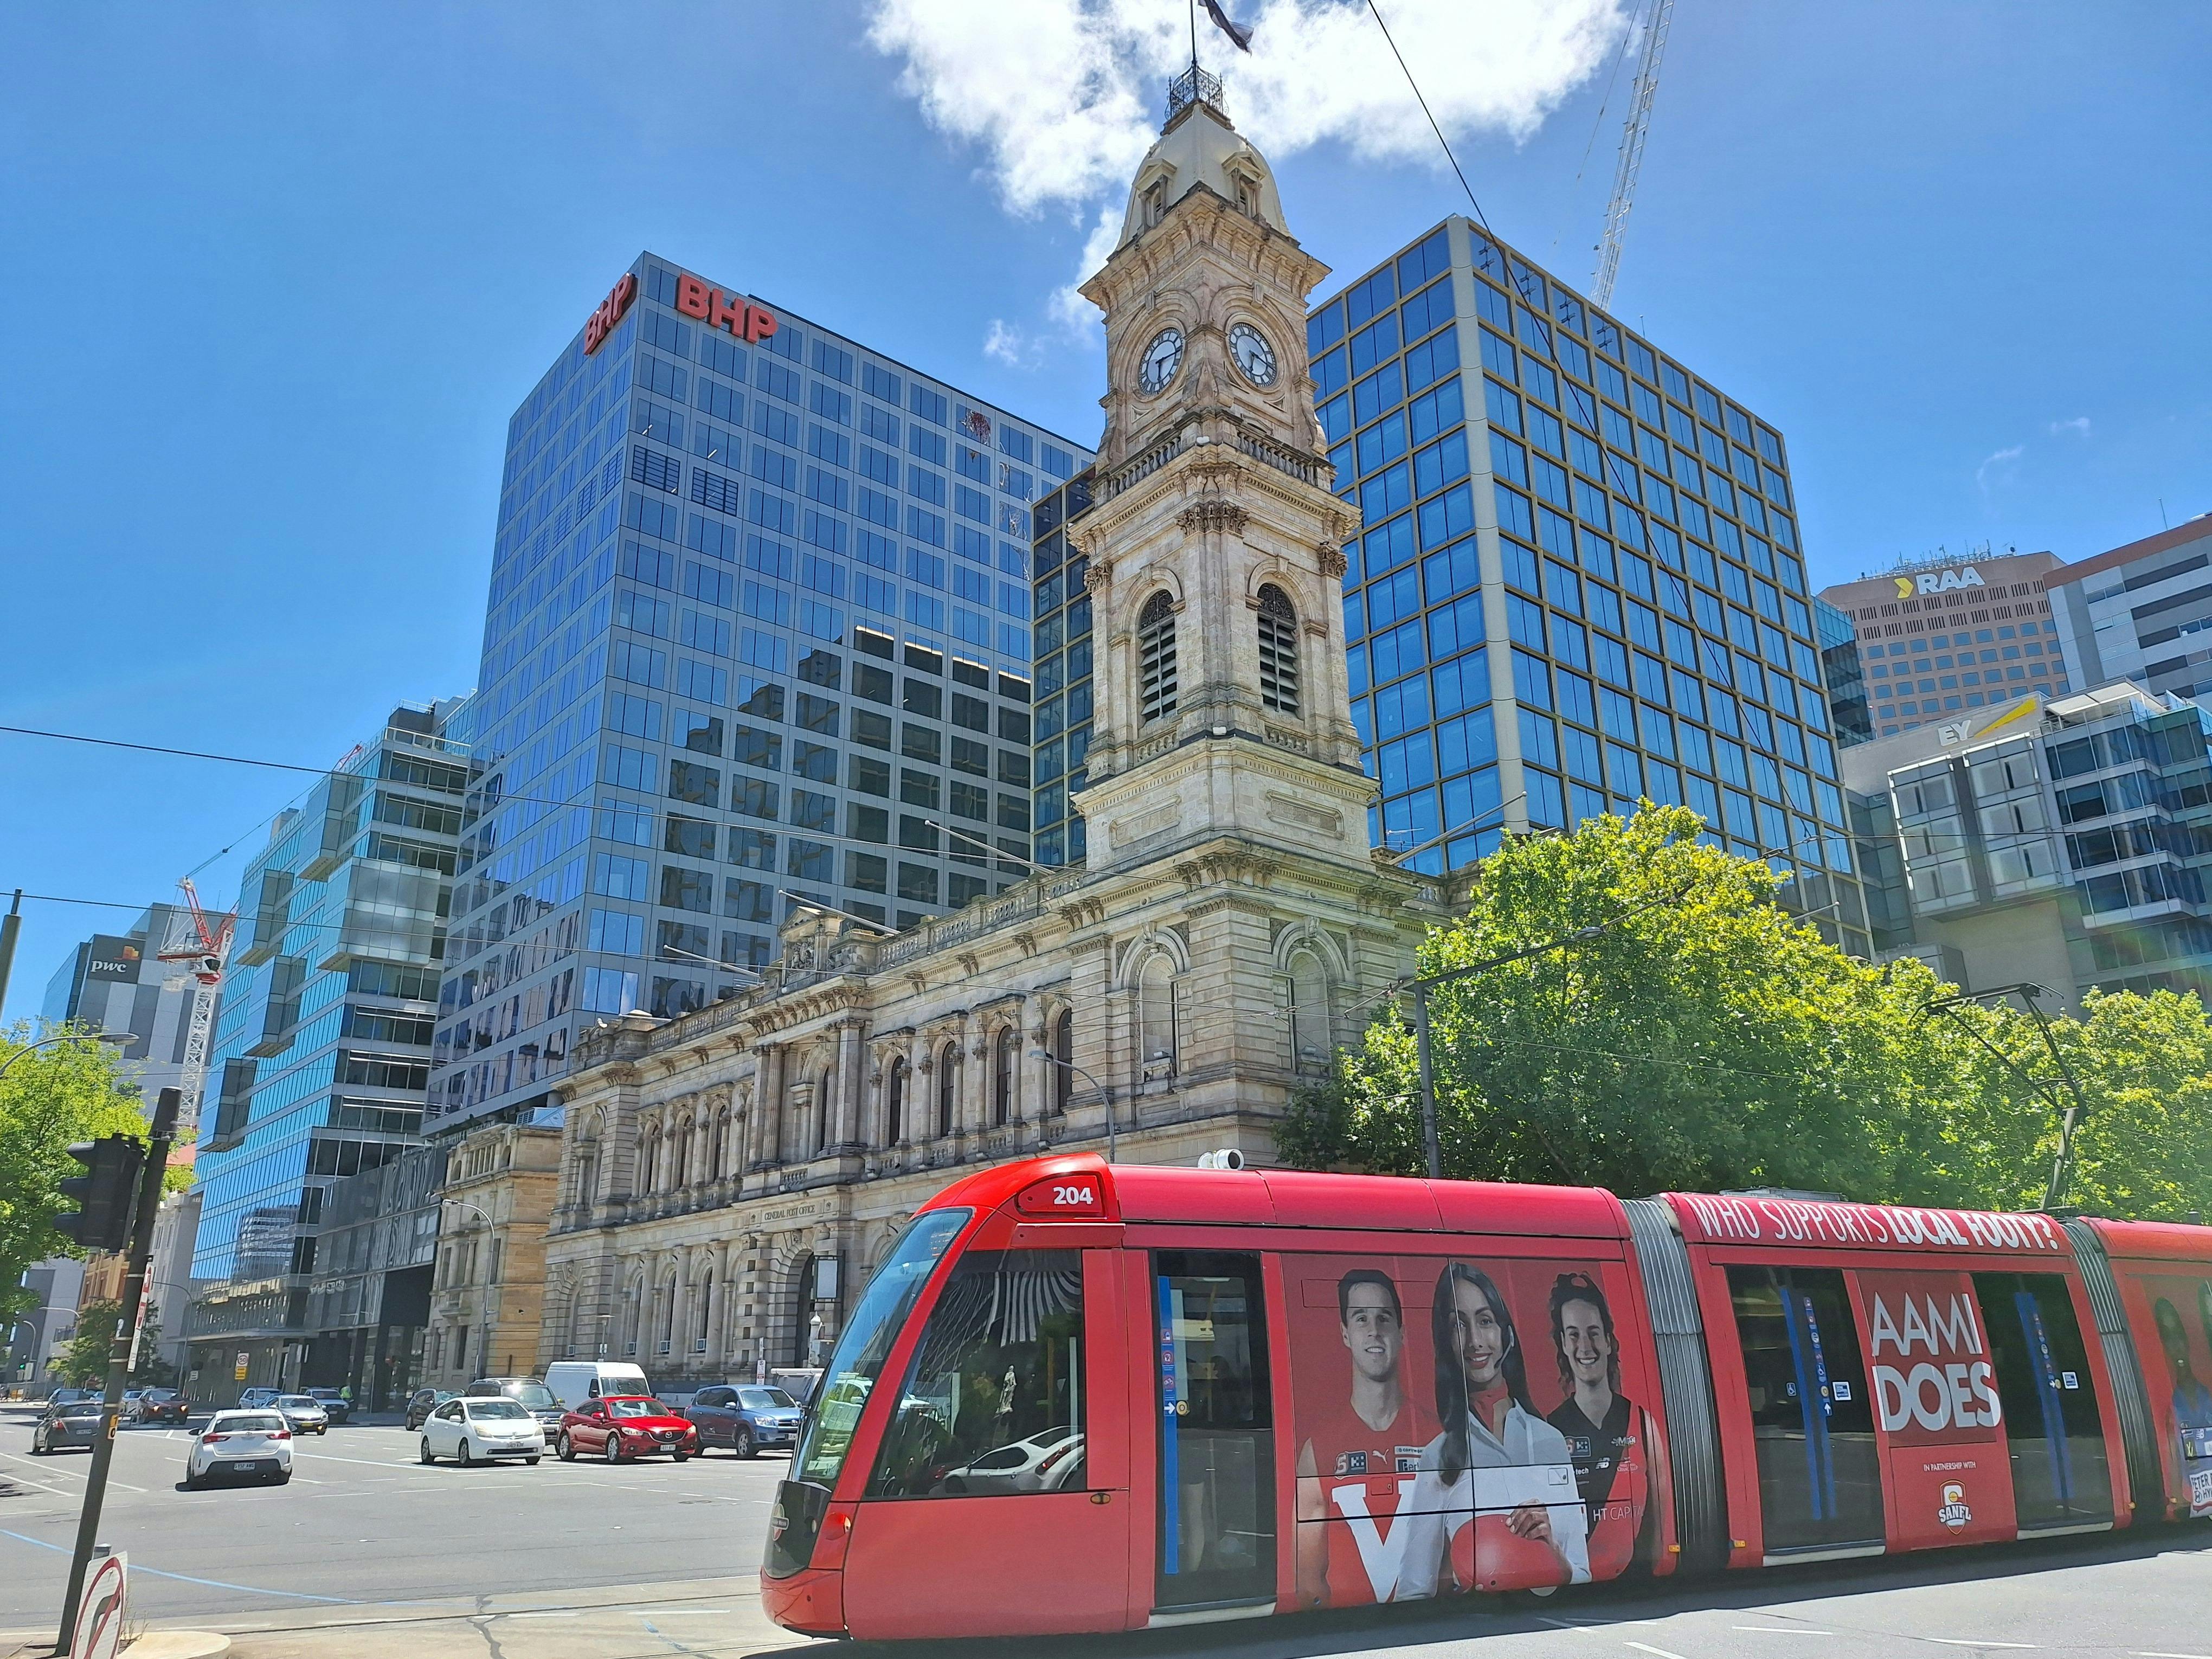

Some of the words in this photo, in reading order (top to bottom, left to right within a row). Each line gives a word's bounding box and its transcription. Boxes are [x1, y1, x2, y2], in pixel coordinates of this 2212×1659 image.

[583, 272, 634, 355] BHP
[677, 273, 777, 343] BHP
[1915, 566, 1985, 595] RAA
[1938, 719, 1971, 746] EY
[90, 960, 127, 973] pwc
[1053, 1187, 1094, 1205] 204
[787, 1207, 799, 1218] POST
[799, 1204, 815, 1215] OFFICE
[1683, 1197, 1760, 1239] WHO
[1758, 1200, 1888, 1243] SUPPORTS
[1876, 1207, 1970, 1245] LOCAL
[1956, 1212, 2058, 1250] FOOTY?
[1872, 1291, 1983, 1356] AAMI
[1872, 1361, 2001, 1431] DOES
[1924, 1464, 1930, 1472] IN
[1931, 1462, 1963, 1471] PARTNERSHIP
[2203, 1488, 2212, 1500] HY
[1938, 1505, 1972, 1523] SANFL
